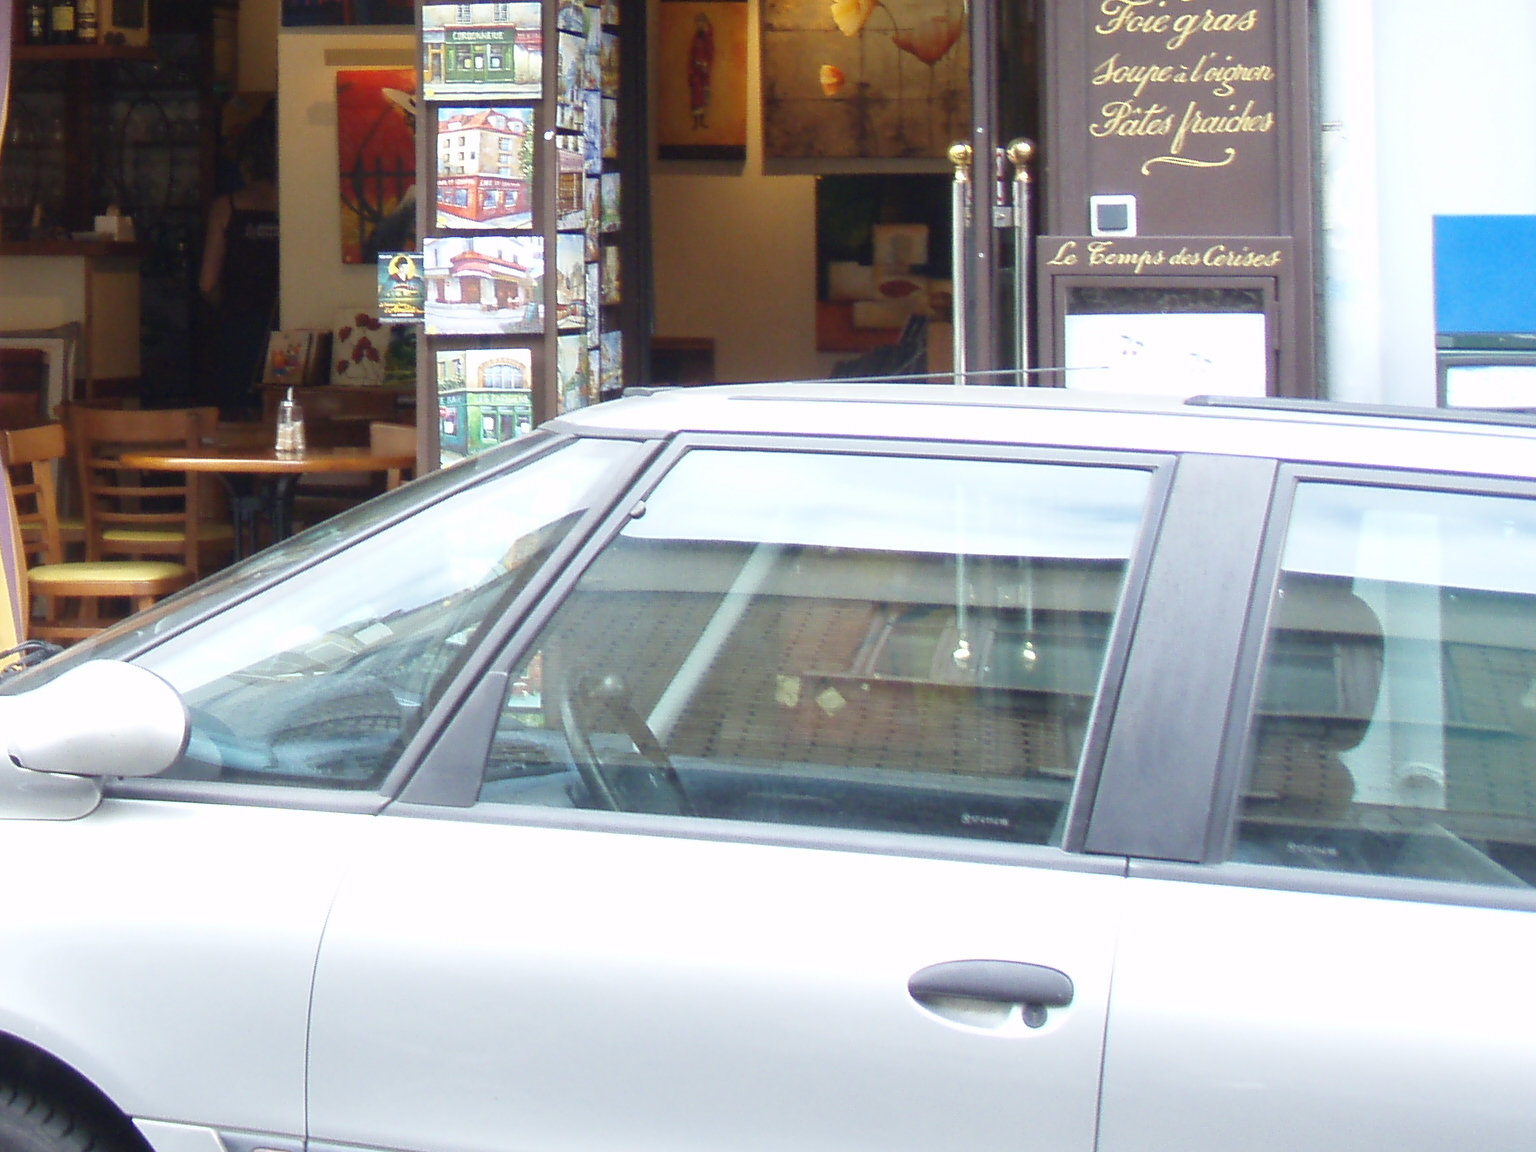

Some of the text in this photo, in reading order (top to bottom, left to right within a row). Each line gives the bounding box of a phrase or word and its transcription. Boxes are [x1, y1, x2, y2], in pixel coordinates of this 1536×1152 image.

[1166, 9, 1259, 50] gras
[1092, 52, 1173, 97] Soupe
[1173, 64, 1188, 83] à
[1046, 240, 1283, 274] Le Temps des Cerises
